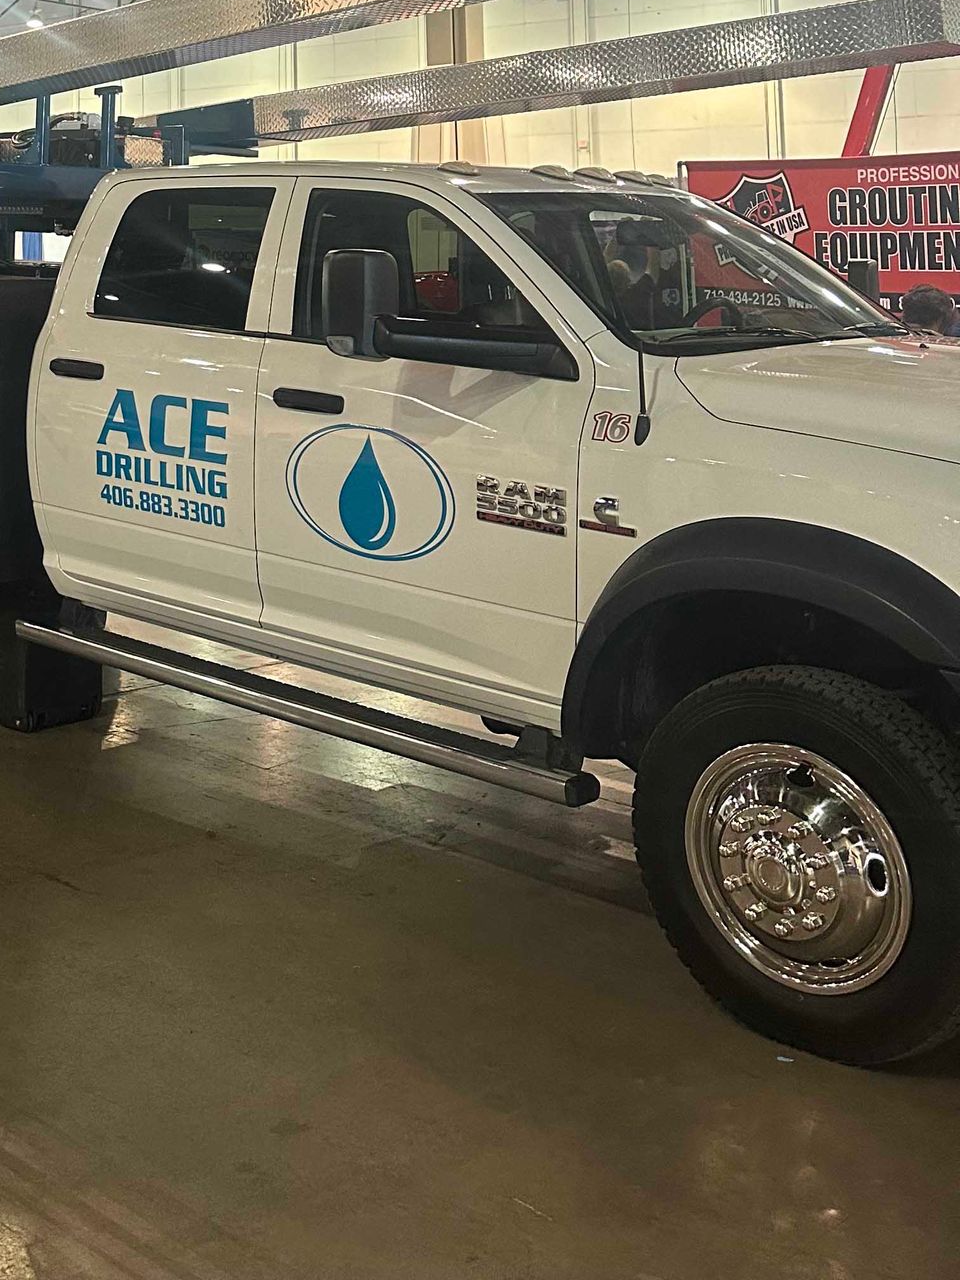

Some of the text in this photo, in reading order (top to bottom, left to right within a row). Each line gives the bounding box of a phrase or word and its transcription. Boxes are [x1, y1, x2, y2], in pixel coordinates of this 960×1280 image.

[857, 164, 960, 183] PROFESSION
[775, 218, 788, 236] IN
[785, 212, 806, 232] USA
[828, 183, 960, 228] GROUTIN
[814, 231, 960, 276] EQUIPMEN
[96, 388, 230, 466] ACE
[591, 410, 632, 444] 16
[96, 449, 228, 500] DRILLING
[476, 473, 568, 508] RAM
[100, 483, 226, 528] 406.883.3300
[476, 492, 568, 525] 5500
